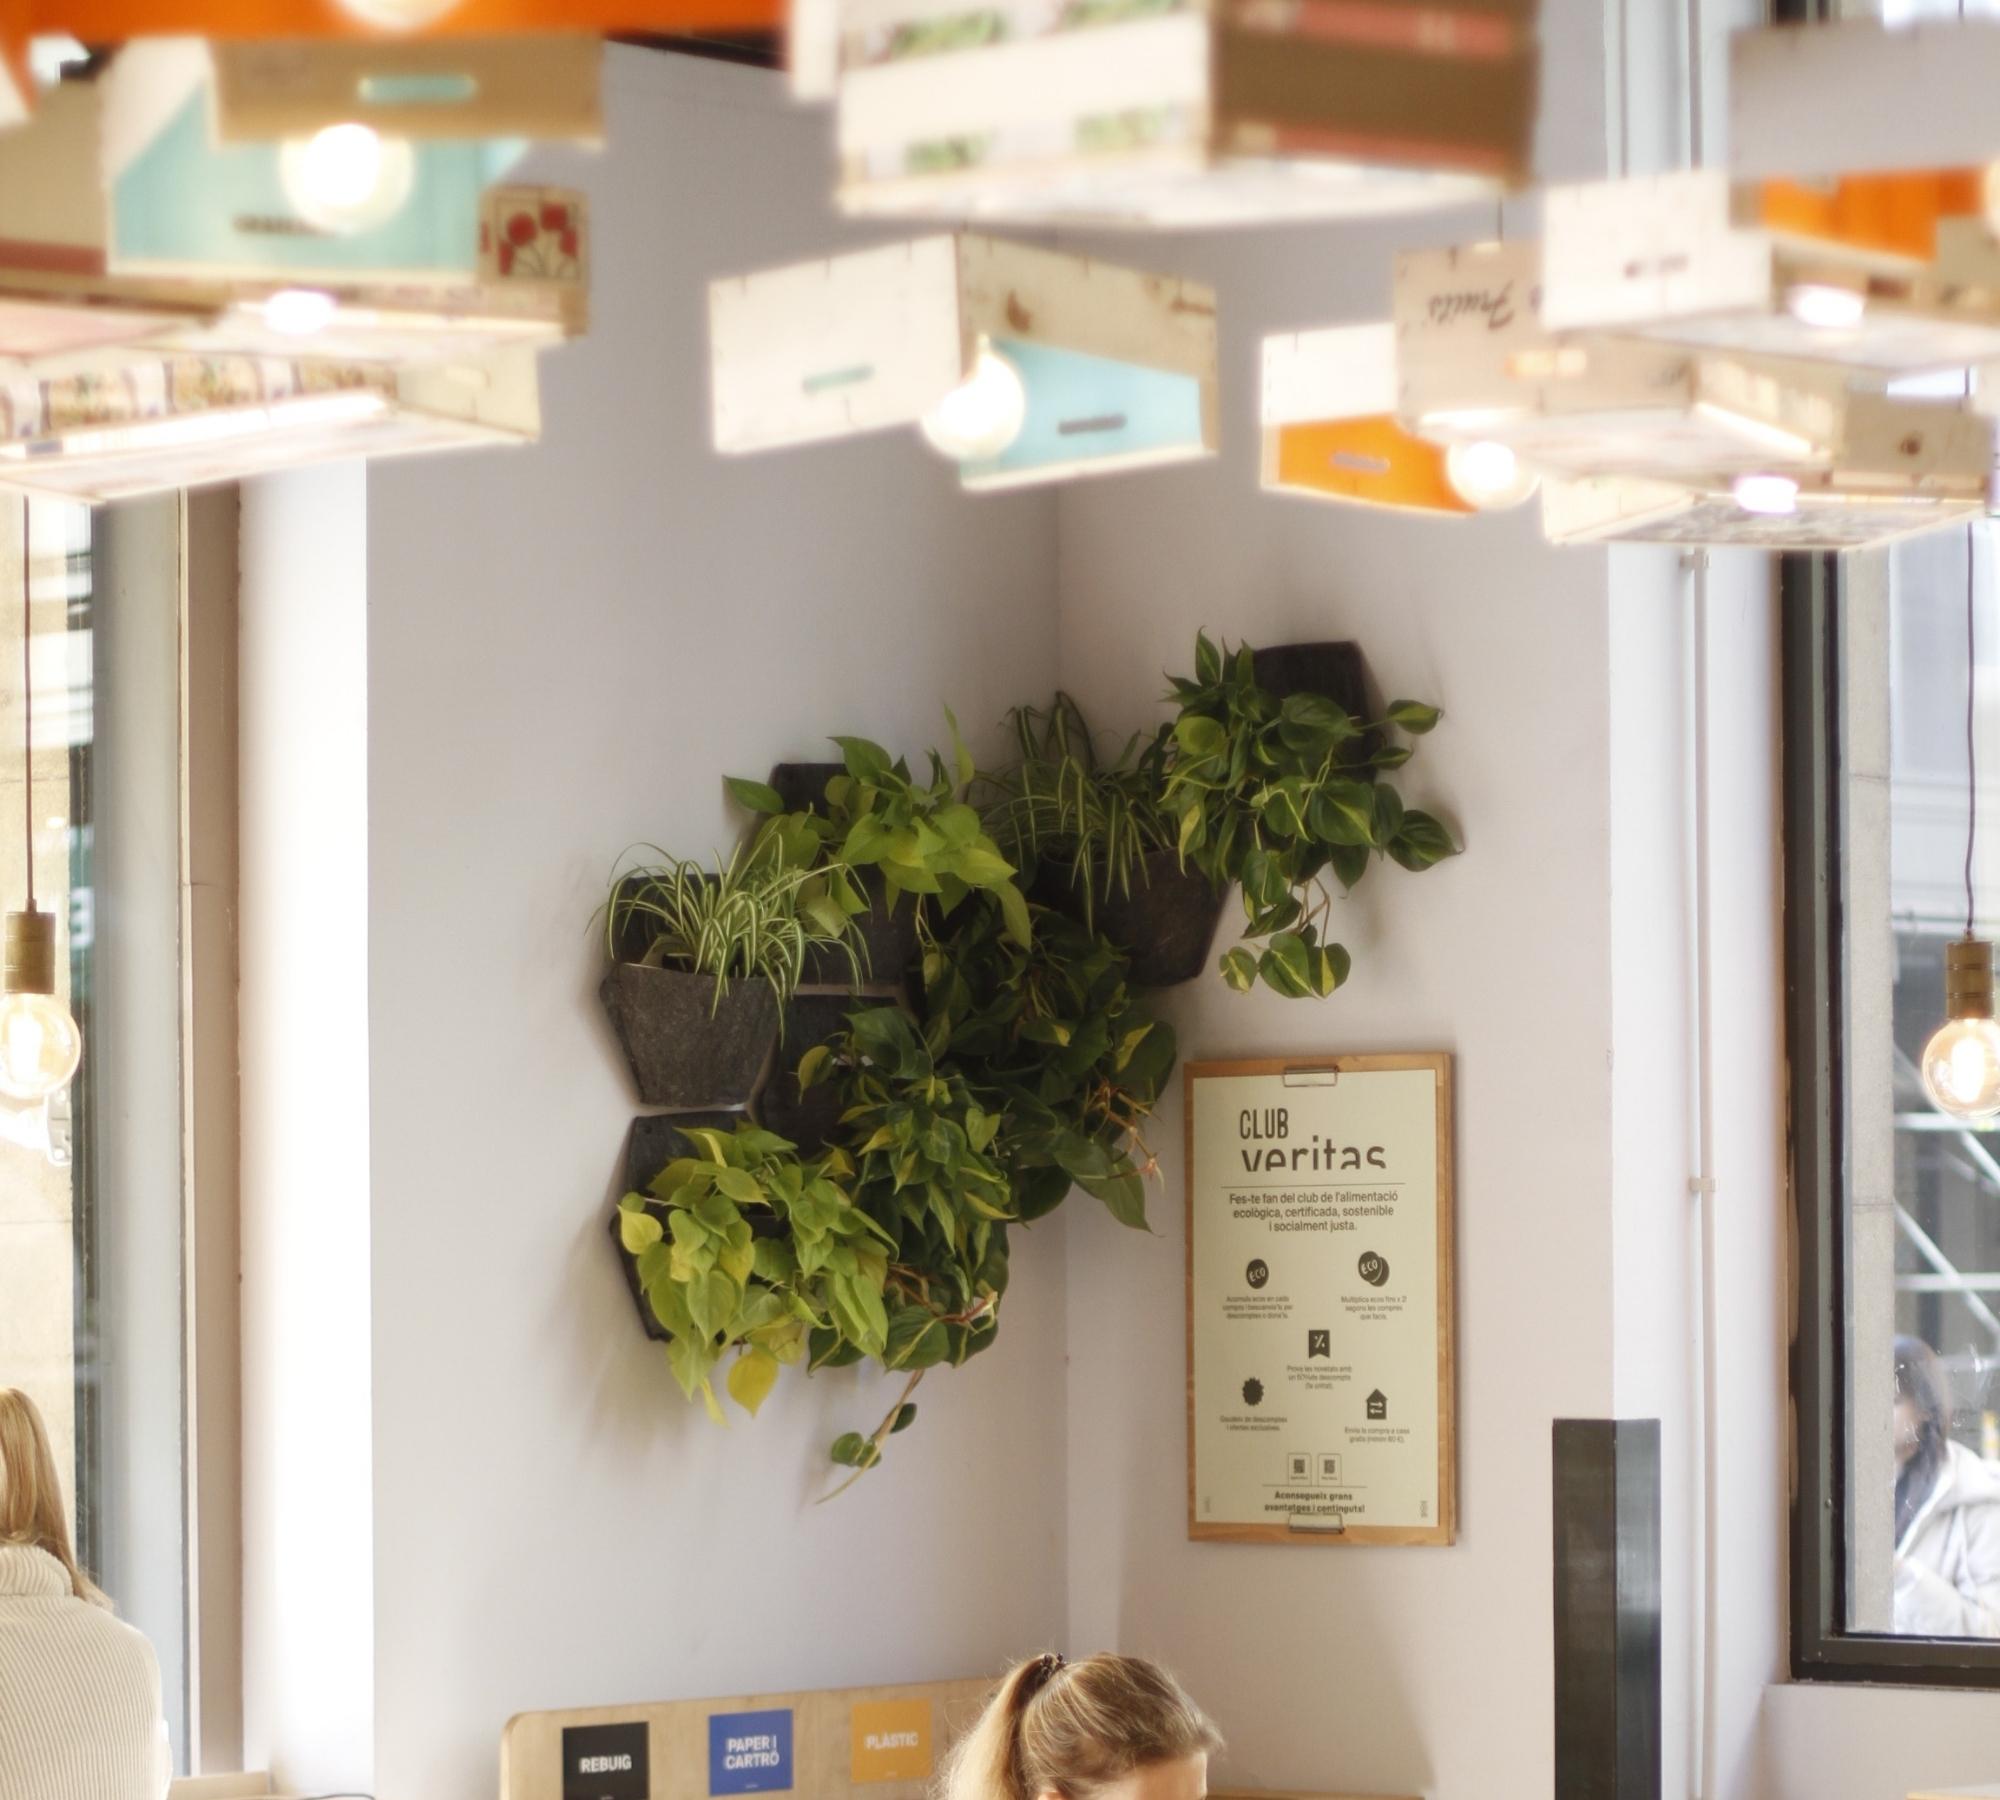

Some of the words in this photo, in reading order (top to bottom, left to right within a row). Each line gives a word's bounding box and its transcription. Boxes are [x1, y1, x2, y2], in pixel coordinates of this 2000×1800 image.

[1239, 1107, 1289, 1140] CLUB
[1241, 1134, 1387, 1172] veritas
[1229, 1193, 1261, 1205] Fes-te
[1263, 1193, 1278, 1204] fan
[1280, 1192, 1295, 1204] del
[1297, 1192, 1319, 1204] club
[1320, 1192, 1333, 1203] de
[1335, 1190, 1398, 1203] l'alimentació
[1285, 1206, 1341, 1219] certificada,
[1342, 1205, 1394, 1217] sostenible
[1274, 1221, 1329, 1232] socialment
[1330, 1220, 1357, 1233] justa.
[1248, 1266, 1266, 1282] ECO
[1361, 1258, 1379, 1275] ECO
[727, 1736, 770, 1753] PAPER
[580, 1754, 632, 1773] REBUIG
[725, 1750, 780, 1769] CARTRÓ
